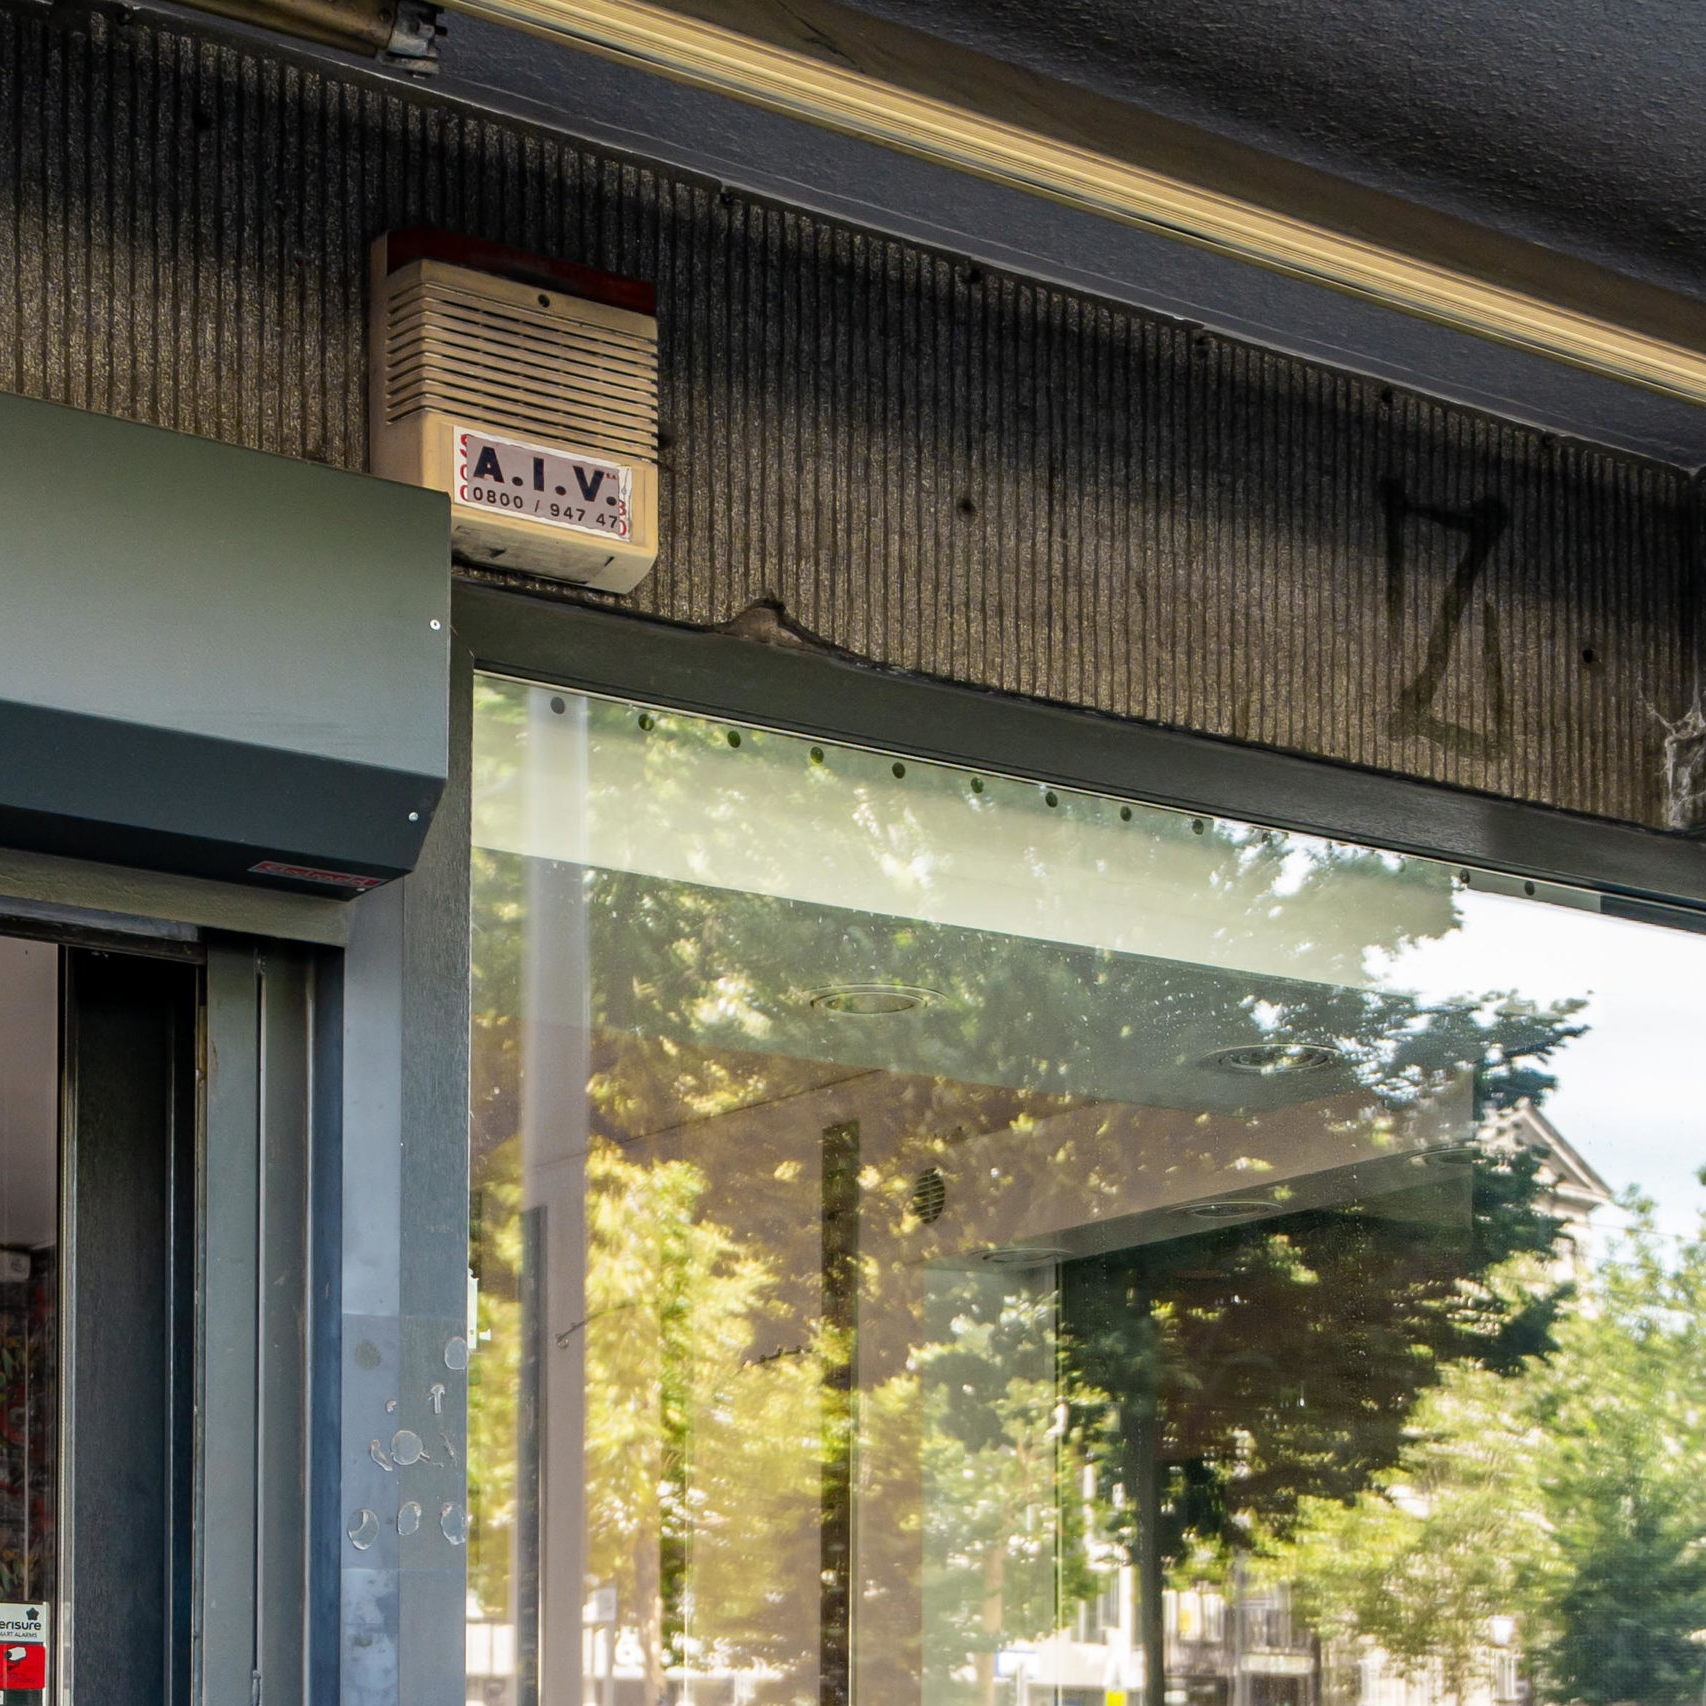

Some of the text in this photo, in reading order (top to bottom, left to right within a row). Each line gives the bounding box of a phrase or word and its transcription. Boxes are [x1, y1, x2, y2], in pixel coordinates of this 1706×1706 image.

[473, 446, 617, 506] A.I.V.
[473, 487, 524, 509] 0800
[550, 503, 586, 522] 947
[596, 513, 618, 529] 47
